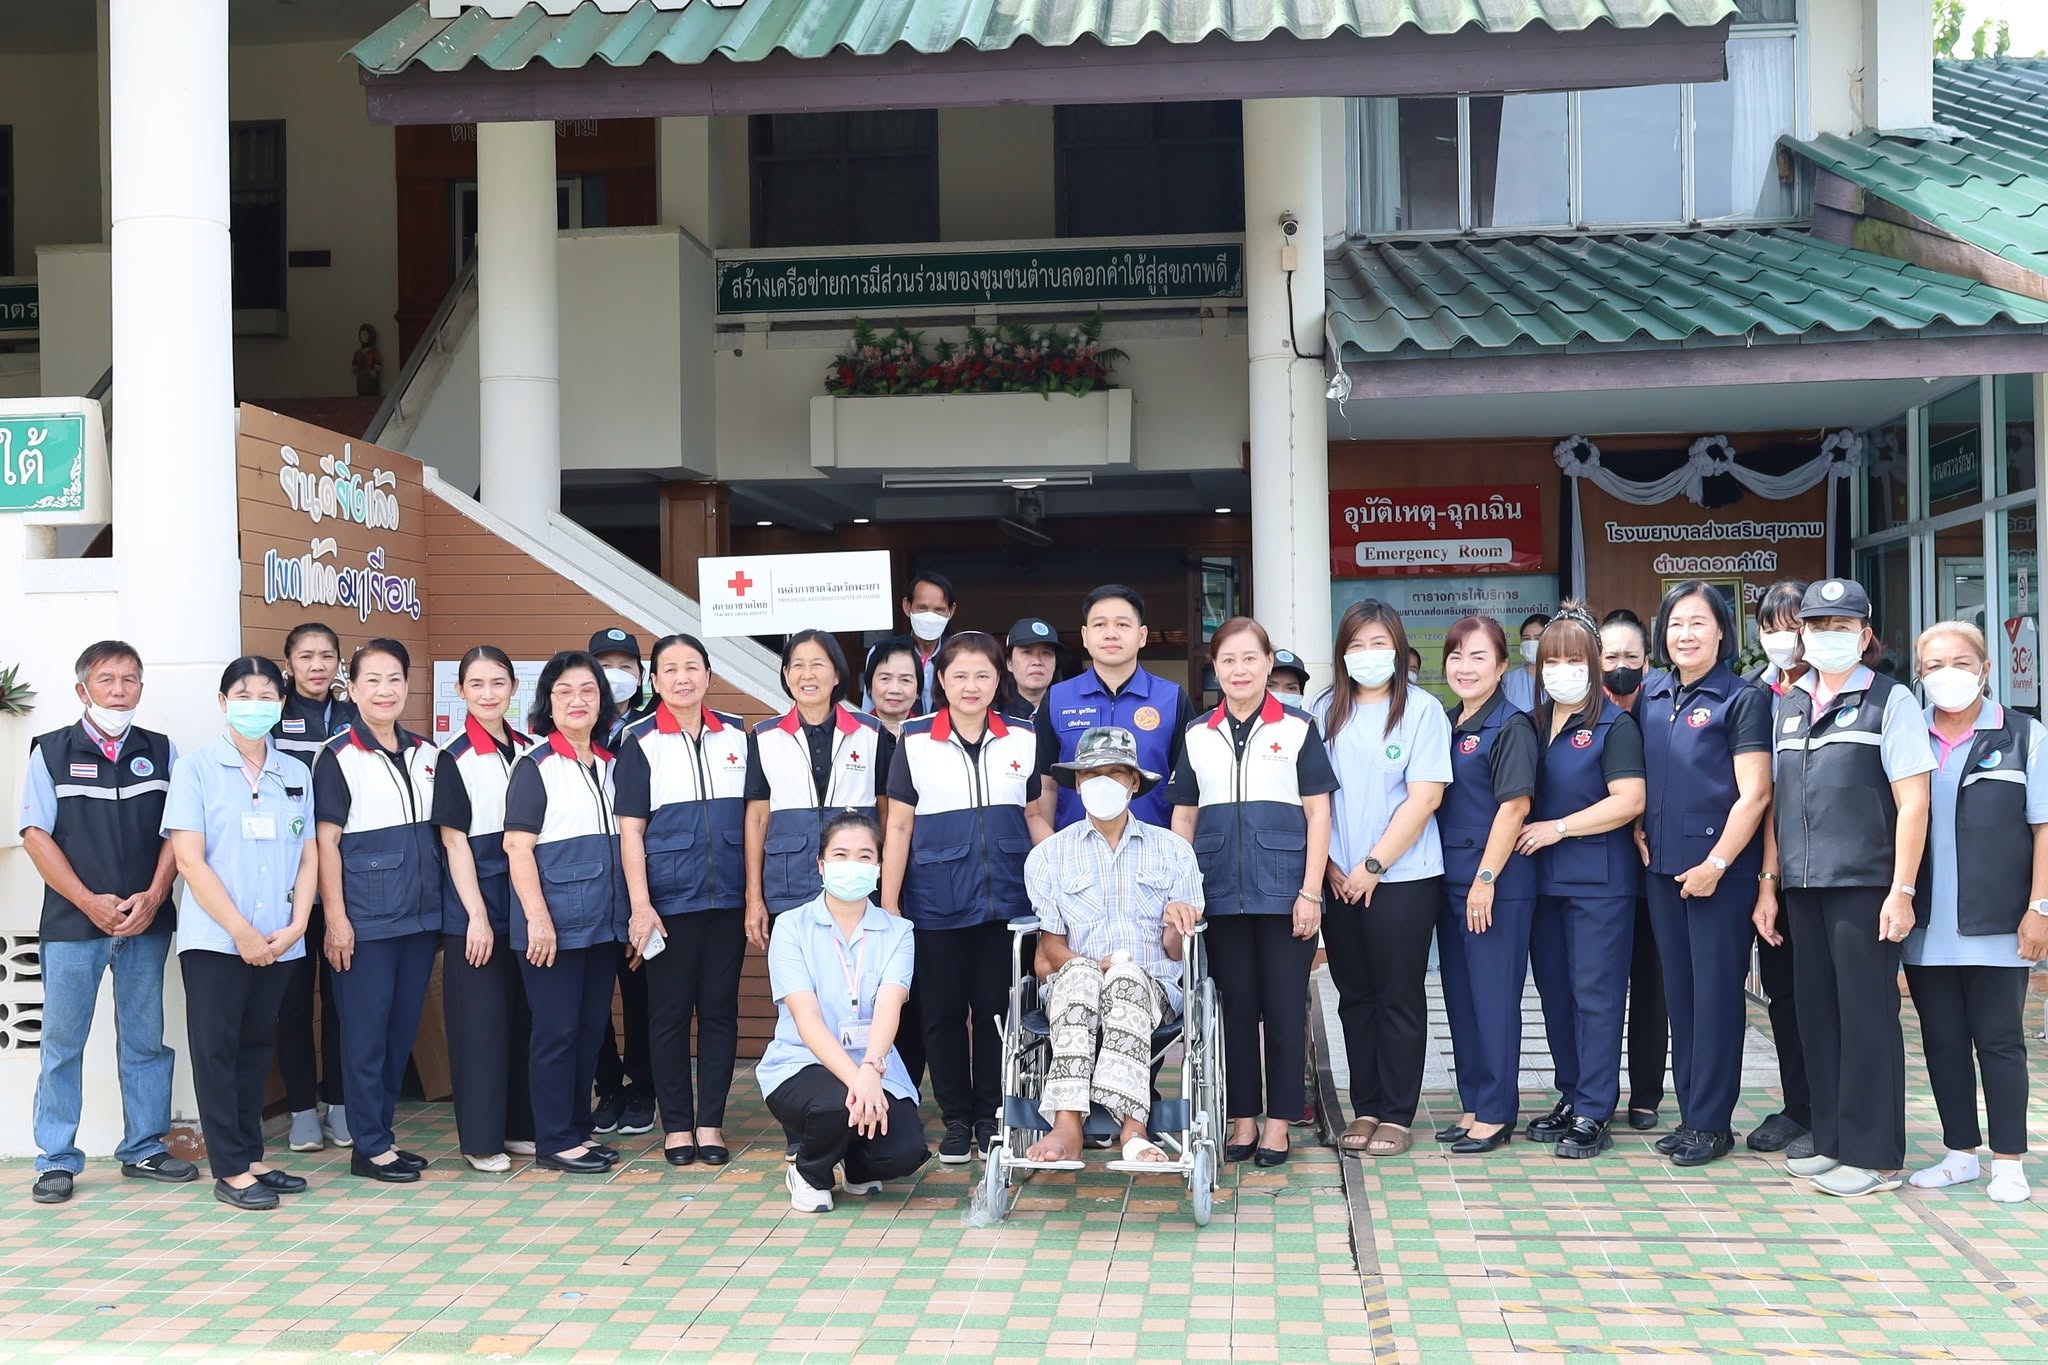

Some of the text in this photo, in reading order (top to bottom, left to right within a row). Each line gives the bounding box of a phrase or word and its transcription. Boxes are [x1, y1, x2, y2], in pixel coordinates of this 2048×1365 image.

[731, 252, 1228, 300] สร้างเครือข่ายการมีส่วนร่วมของชุมชนตำบลดอกคำใต้สู่สุขภาพดี
[1343, 494, 1522, 533] อุบัติเหตุ-ฉุกเฉิน
[1605, 519, 1825, 543] โรงพยาบาลส่งเสริมสุขภาพ
[1364, 544, 1503, 563] Emergency Room
[1653, 550, 1777, 574] ตำบลดอกคำใต้
[777, 581, 880, 595] เหล่ากาชาดจังหวัดพะเยา
[1412, 587, 1519, 602] ตารางการให้บริการ
[712, 600, 768, 611] สภากาชาดไทย
